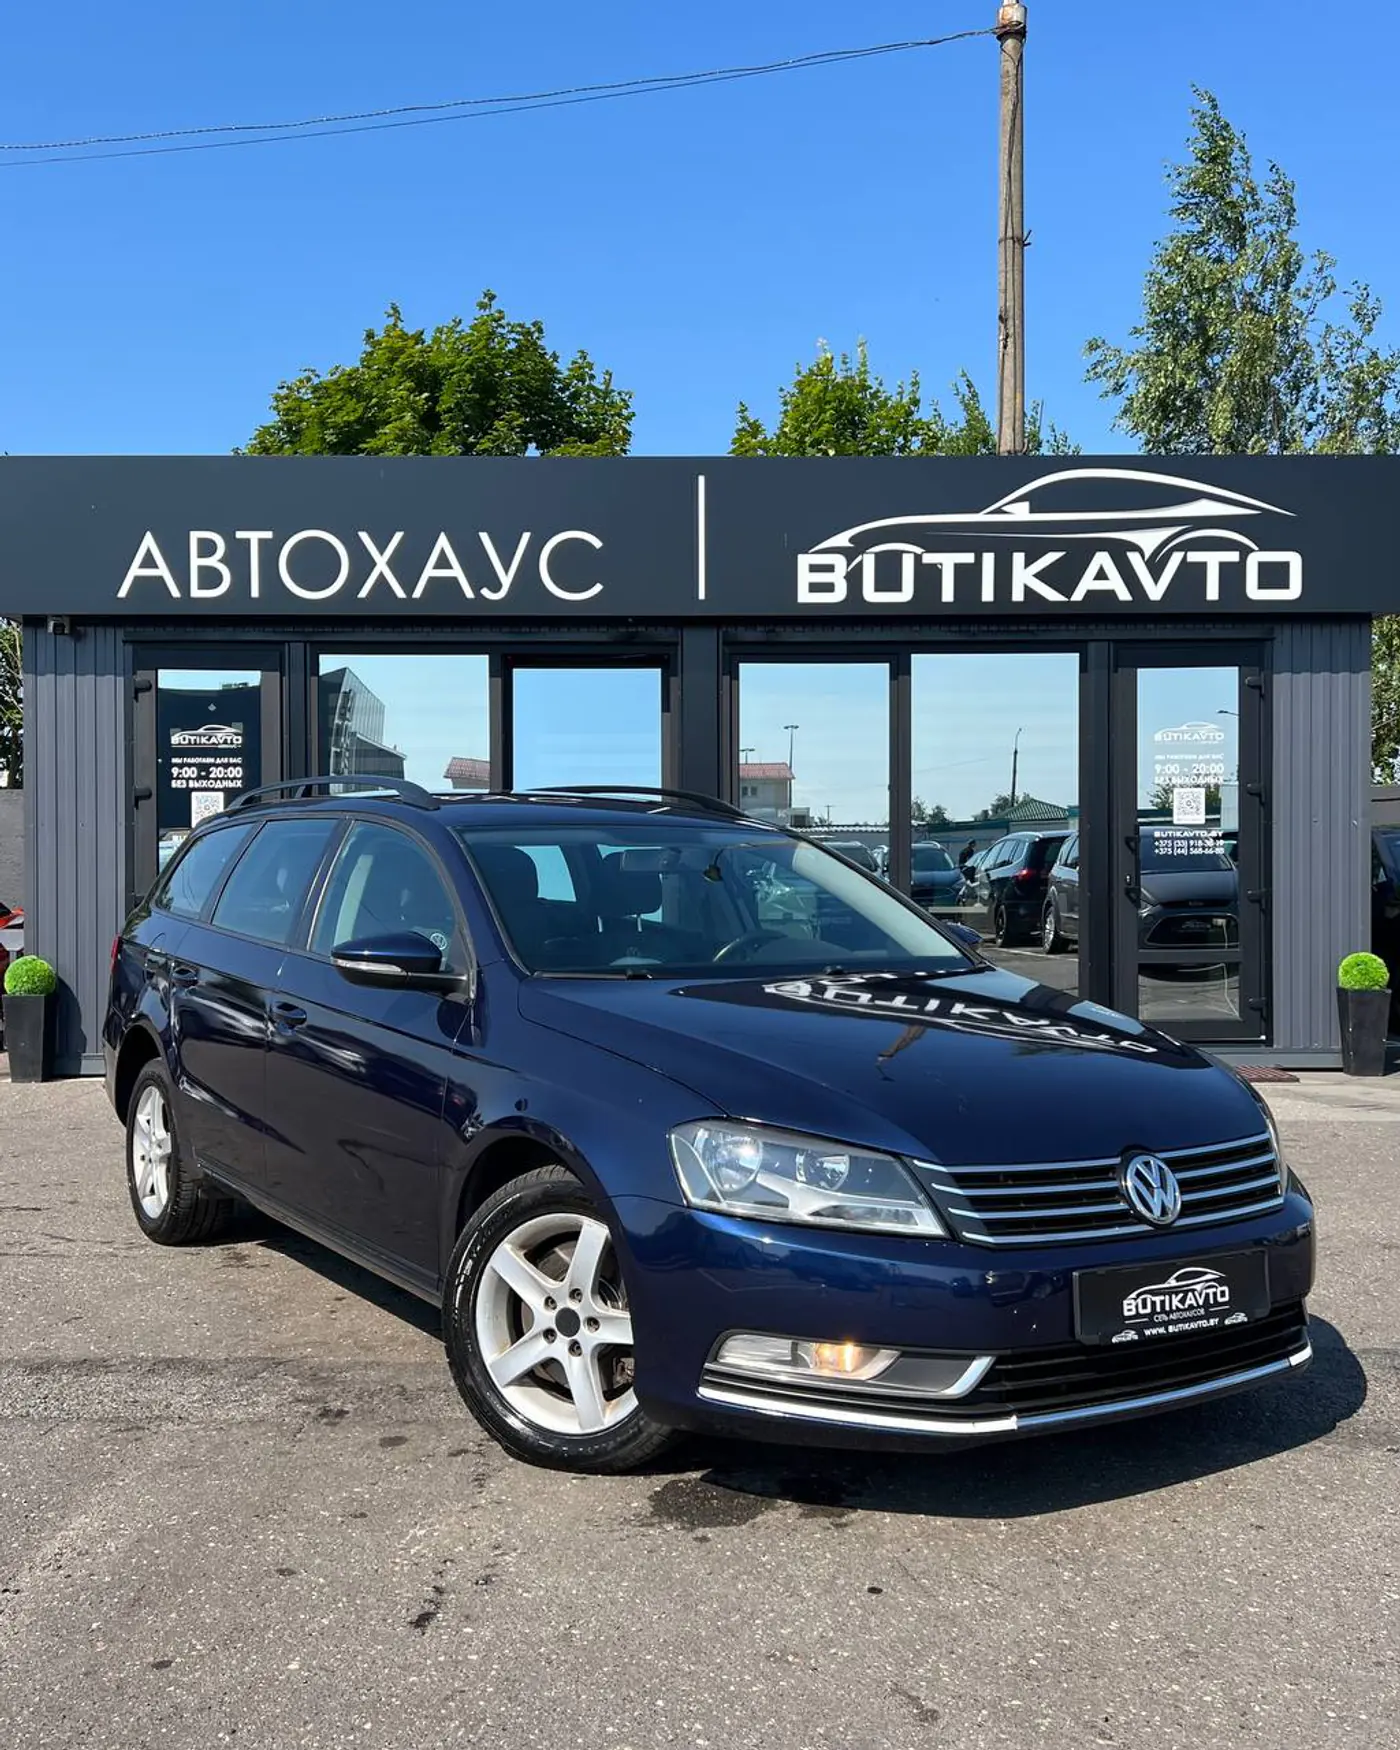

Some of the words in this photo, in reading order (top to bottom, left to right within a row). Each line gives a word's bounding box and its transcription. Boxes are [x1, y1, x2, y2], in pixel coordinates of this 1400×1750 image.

[116, 528, 605, 602] АВТОХАУС
[796, 550, 1303, 604] BUTIKAVTO
[171, 735, 242, 745] BUTIKAVTO
[1154, 732, 1225, 742] BUTIKAVTO
[171, 766, 198, 778] 9:00
[209, 766, 243, 778] 20:00
[1154, 763, 1180, 774] 9:00
[1191, 763, 1225, 774] 20:00
[171, 779, 187, 788] БЕЗ
[188, 779, 243, 788] ВЫХОДНЫХ
[1154, 840, 1172, 848] +375
[1173, 848, 1188, 856] (44)
[1123, 1285, 1230, 1317] BUTIKAVTO
[1167, 1317, 1220, 1334] BUTIKAVTO.BY
